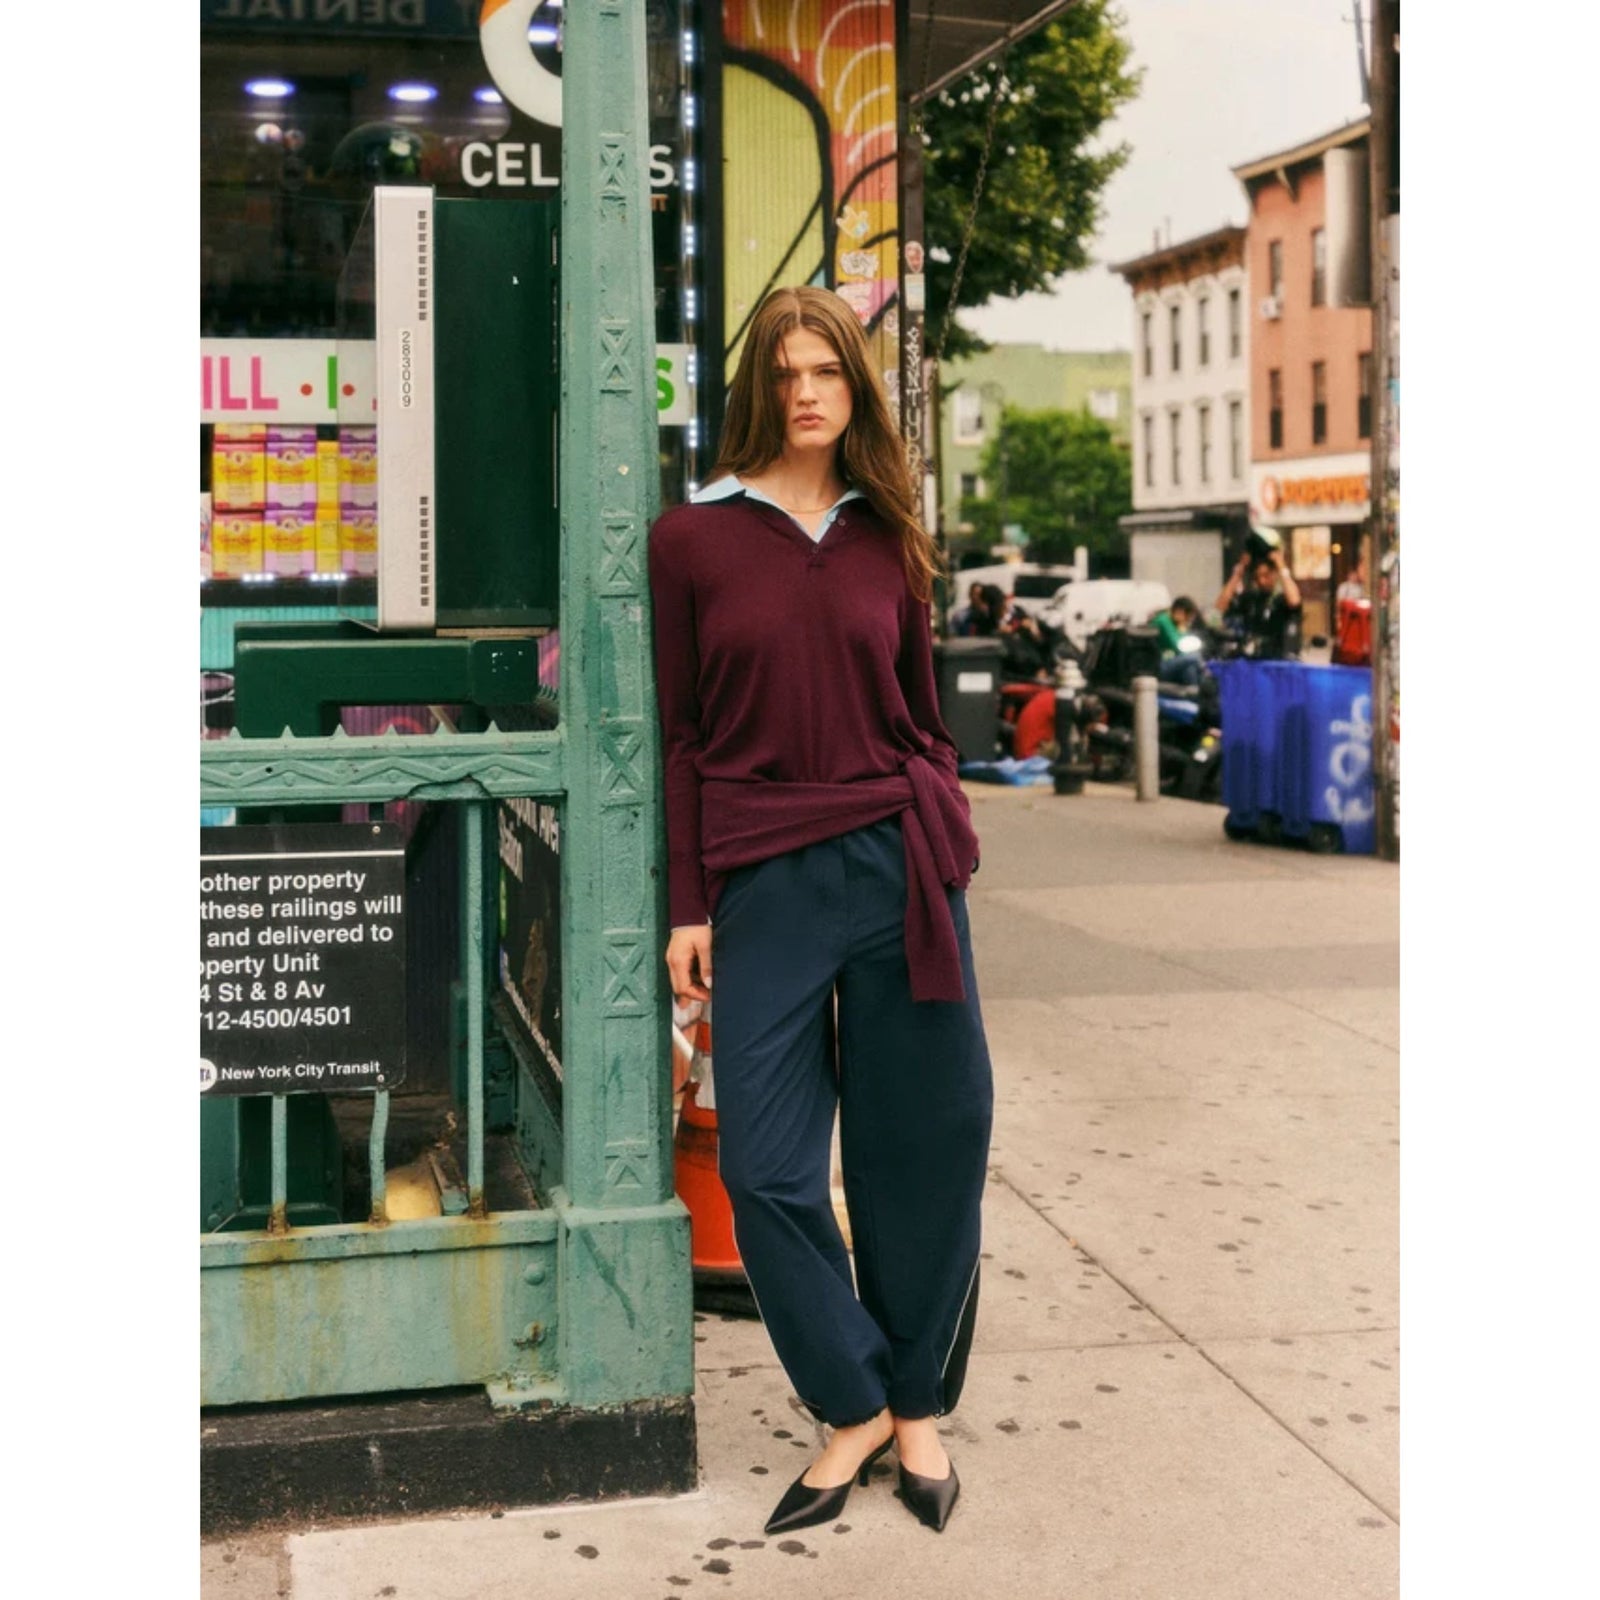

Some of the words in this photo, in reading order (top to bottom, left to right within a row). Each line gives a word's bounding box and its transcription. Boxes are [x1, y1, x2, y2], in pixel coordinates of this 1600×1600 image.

[402, 331, 411, 407] 283009
[200, 872, 261, 892] other
[268, 870, 366, 894] property
[200, 900, 264, 920] these
[271, 897, 357, 921] railings
[364, 895, 402, 914] will
[207, 927, 250, 947] and
[257, 924, 364, 946] delivered
[370, 924, 394, 942] to
[200, 956, 265, 979] perty
[273, 952, 320, 973] Unit
[218, 982, 243, 1002] St
[250, 982, 267, 1001] &
[274, 981, 287, 1000] 8
[295, 980, 326, 999] Av
[200, 1006, 351, 1031] 12-4500/4501
[221, 1067, 255, 1080] New
[258, 1065, 291, 1078] York
[295, 1064, 325, 1079] City
[327, 1060, 381, 1075] Transit
